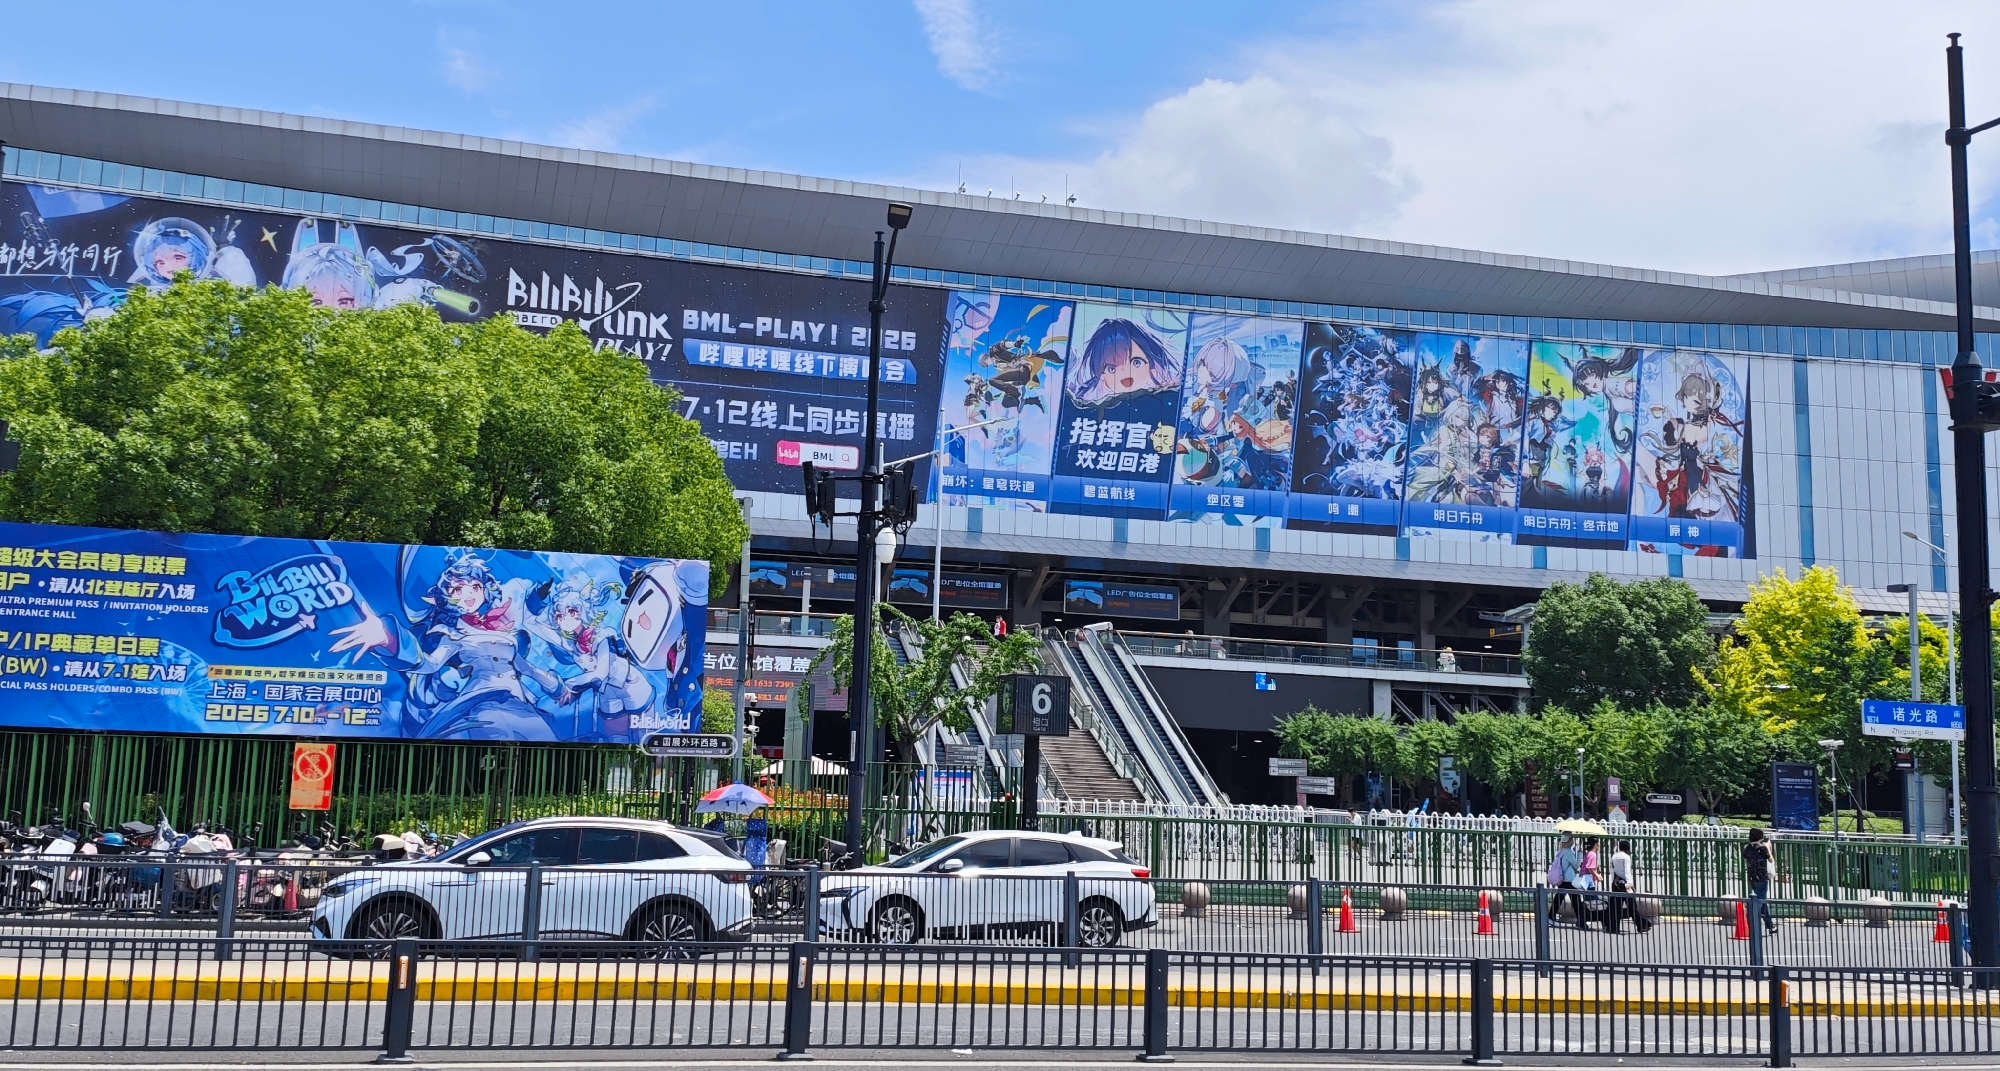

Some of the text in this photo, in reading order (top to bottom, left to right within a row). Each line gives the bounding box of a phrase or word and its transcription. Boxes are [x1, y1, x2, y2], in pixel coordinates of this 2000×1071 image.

[515, 313, 559, 327] acro
[851, 326, 917, 351] 226
[1069, 417, 1152, 450] 指挥官
[813, 451, 834, 462] BML
[1074, 449, 1161, 474] 欢迎回港
[1083, 484, 1136, 500] 碧蓝航线
[1206, 493, 1245, 509] 绝区零
[1433, 509, 1483, 526] 明日方舟
[0, 607, 77, 619] ENTRANCE HALL
[28, 597, 73, 607] PREMIUM
[75, 599, 100, 609] PASS
[109, 601, 165, 611] INVITATION
[165, 604, 209, 614] HOLDERS
[224, 581, 354, 630] WORLD
[703, 652, 812, 673] 告位馆覆盖
[23, 682, 48, 691] PASS
[135, 686, 158, 695] PASS
[160, 686, 183, 696] (BW)
[1031, 682, 1052, 715] 6
[205, 703, 269, 722] 2026
[273, 706, 315, 724] 7.10
[343, 707, 366, 725] 12
[1892, 706, 1938, 724] 诸光路
[662, 737, 718, 748] 国展外环西路
